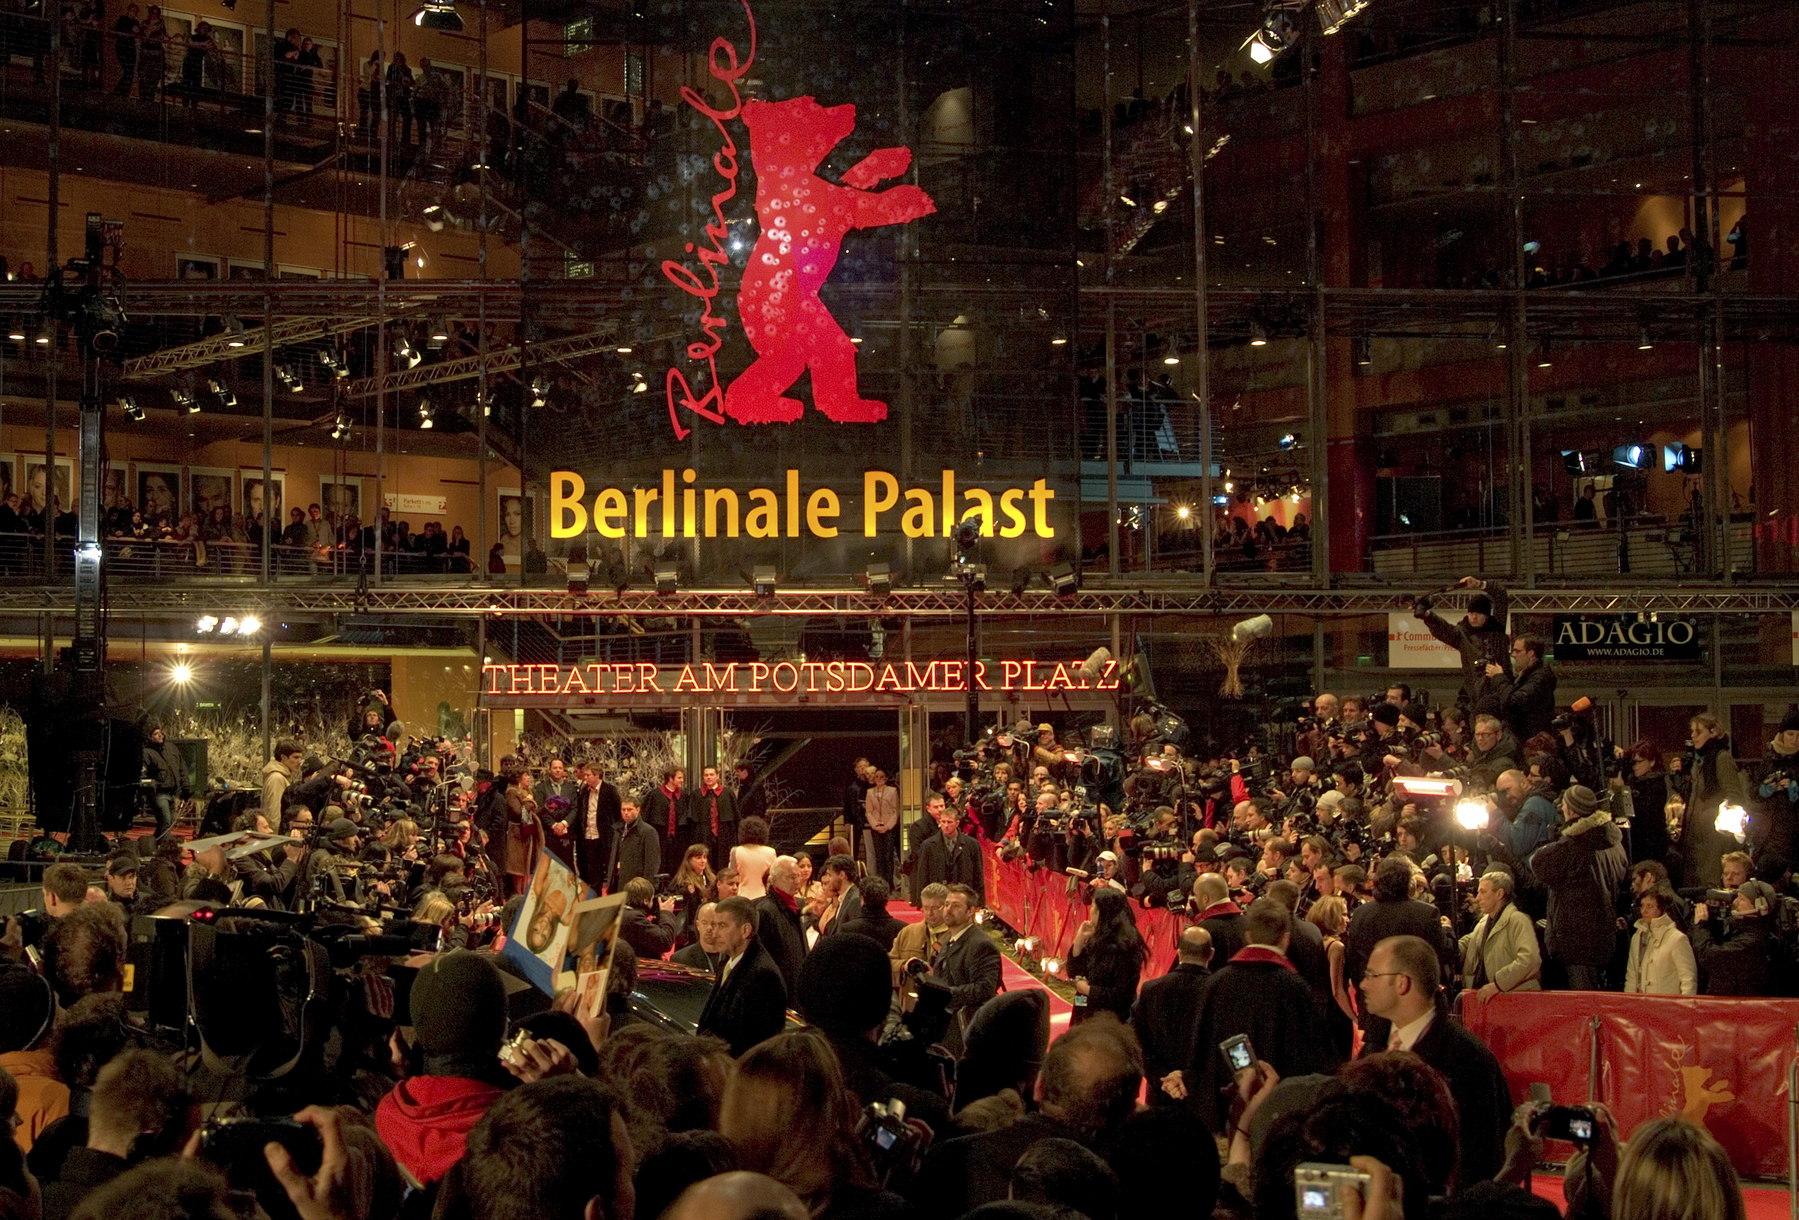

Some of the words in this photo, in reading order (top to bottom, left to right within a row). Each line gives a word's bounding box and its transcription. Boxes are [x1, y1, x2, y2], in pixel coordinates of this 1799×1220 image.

[662, 0, 756, 441] Berlinale
[550, 468, 840, 539] Berlinale
[864, 469, 1055, 539] Palast
[1403, 631, 1437, 641] Commu
[1555, 620, 1694, 645] ADAGIO
[1586, 648, 1665, 657] WWW.ADAGIO.DE
[481, 663, 665, 695] THEATER
[672, 662, 740, 693] AM
[748, 660, 993, 692] POTSDAMER
